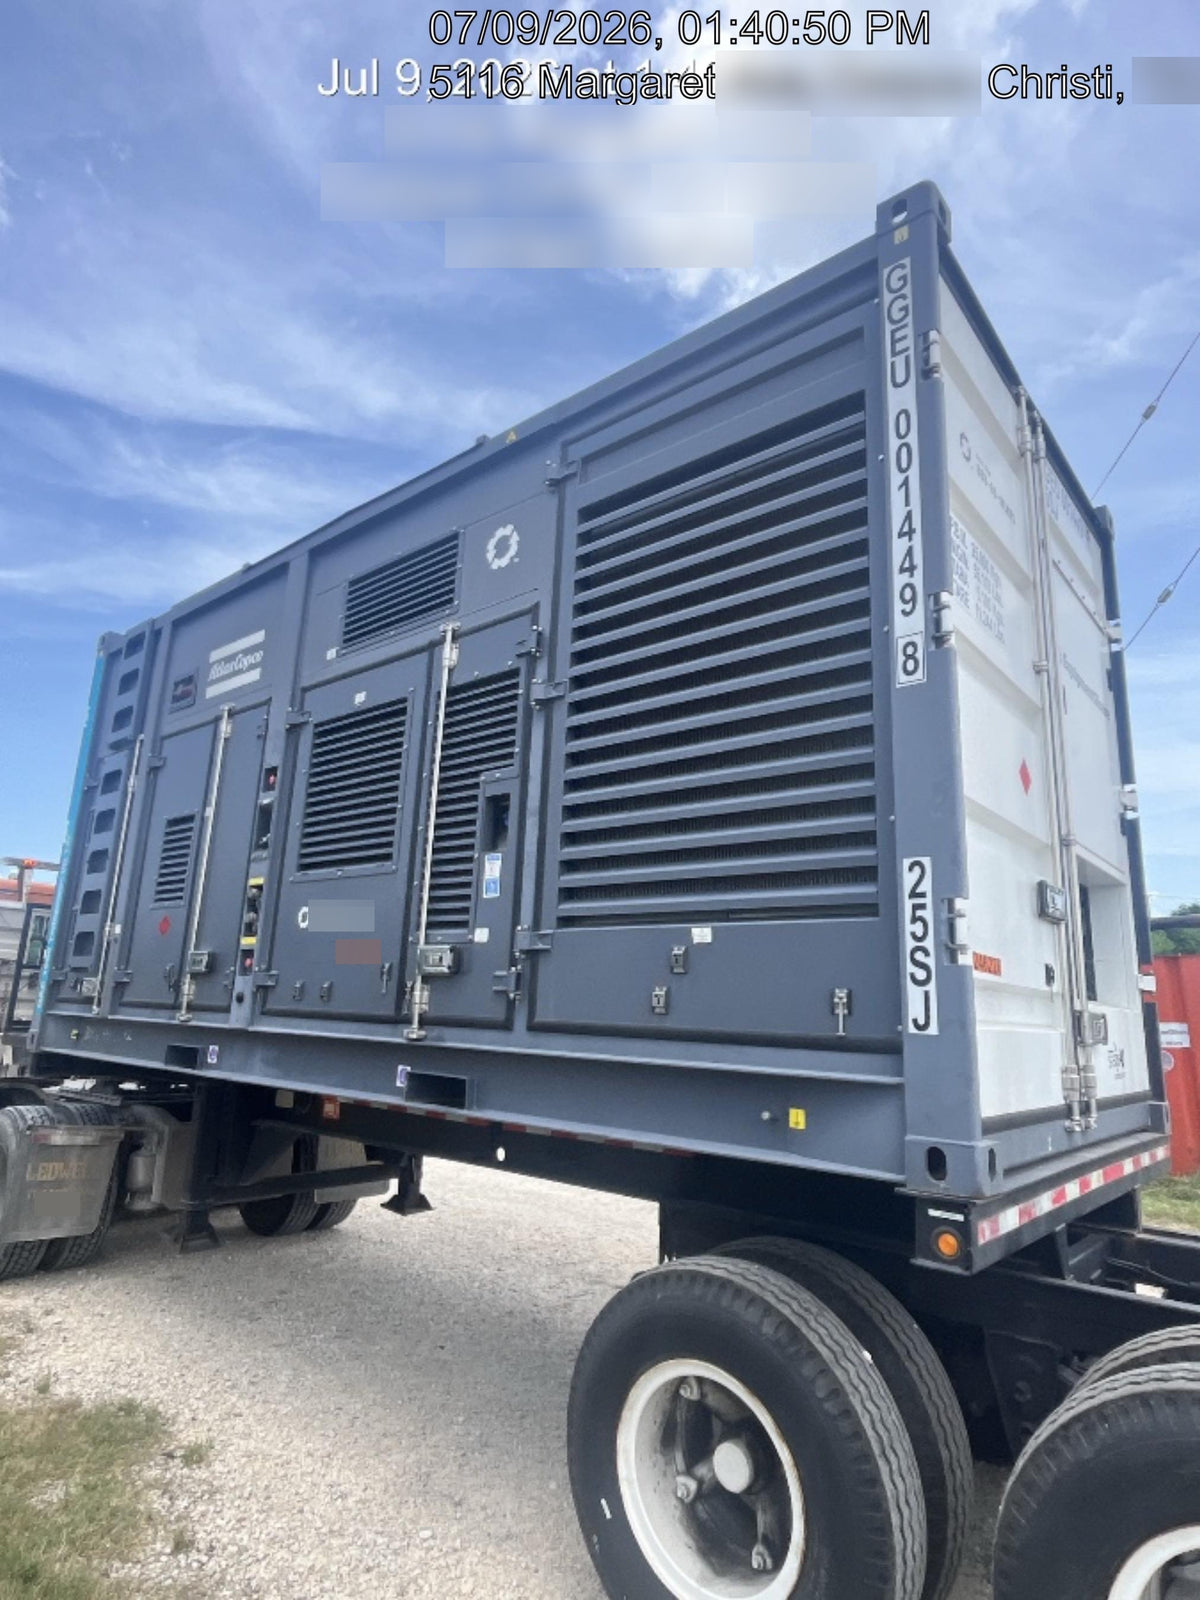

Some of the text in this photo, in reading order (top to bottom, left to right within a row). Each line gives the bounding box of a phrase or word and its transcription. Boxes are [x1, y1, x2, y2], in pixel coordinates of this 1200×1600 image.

[885, 262, 920, 676] GGEU 001449 8
[906, 859, 933, 1033] 25SJ
